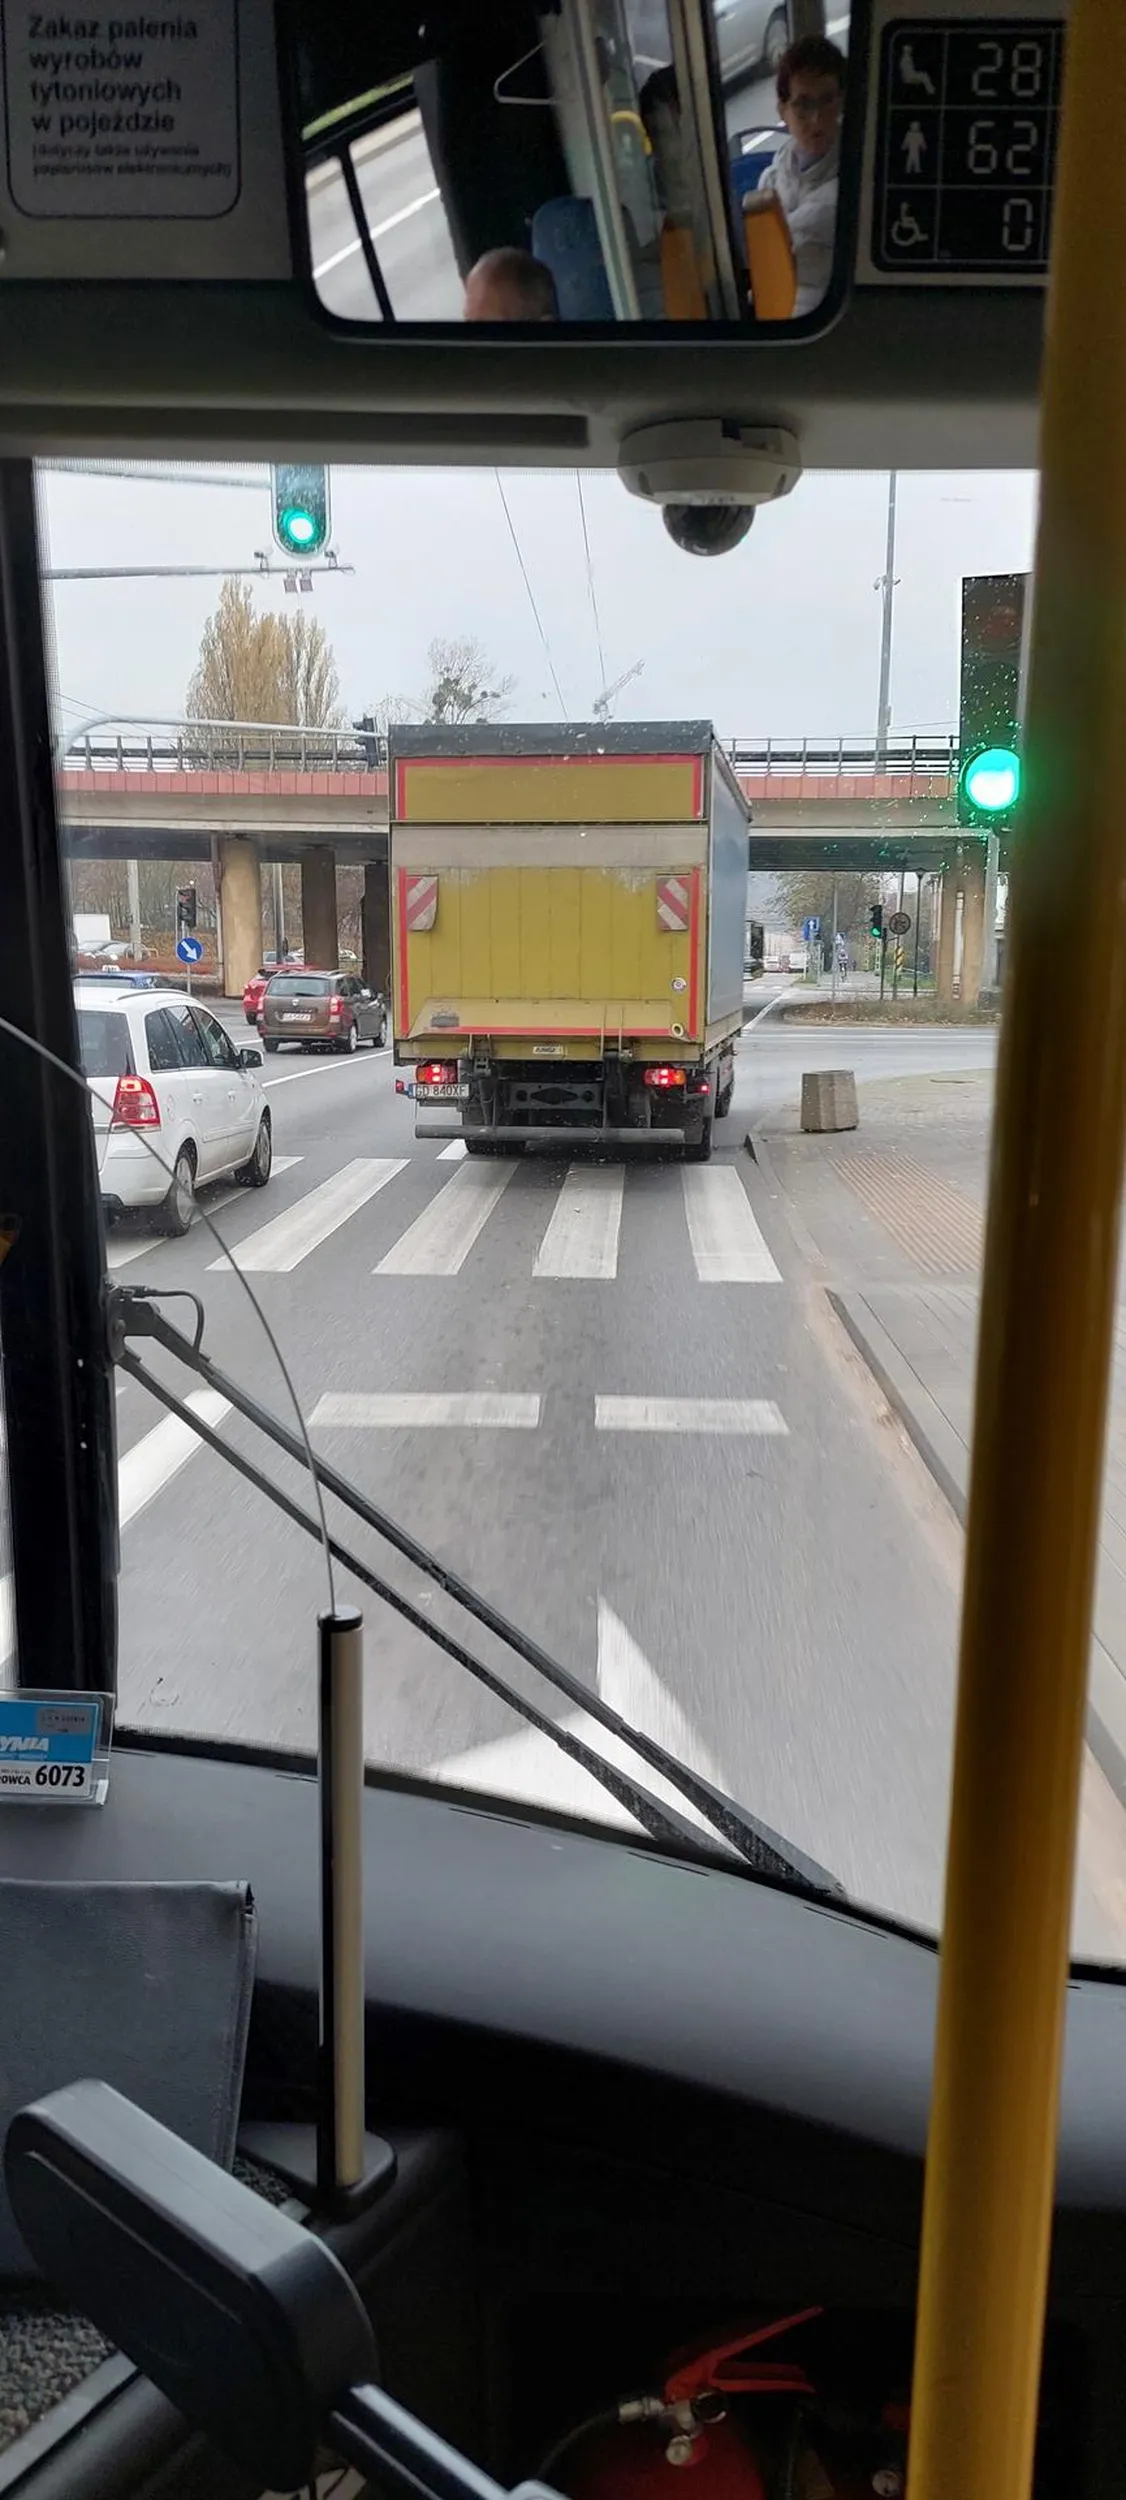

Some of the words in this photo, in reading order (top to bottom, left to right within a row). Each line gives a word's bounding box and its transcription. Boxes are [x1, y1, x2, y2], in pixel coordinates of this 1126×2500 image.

[28, 16, 99, 39] Zakaz
[108, 17, 198, 44] palenia
[30, 47, 143, 74] wyrobów
[971, 41, 1042, 97] 28
[31, 79, 181, 106] tytoniowych
[33, 116, 51, 131] w
[60, 109, 175, 138] pojeździe
[967, 120, 1037, 174] 62
[1002, 198, 1034, 251] 0
[416, 1085, 429, 1097] GD
[0, 1735, 49, 1753] YNIA
[0, 1775, 31, 1785] OWCA
[35, 1765, 85, 1787] 6073
